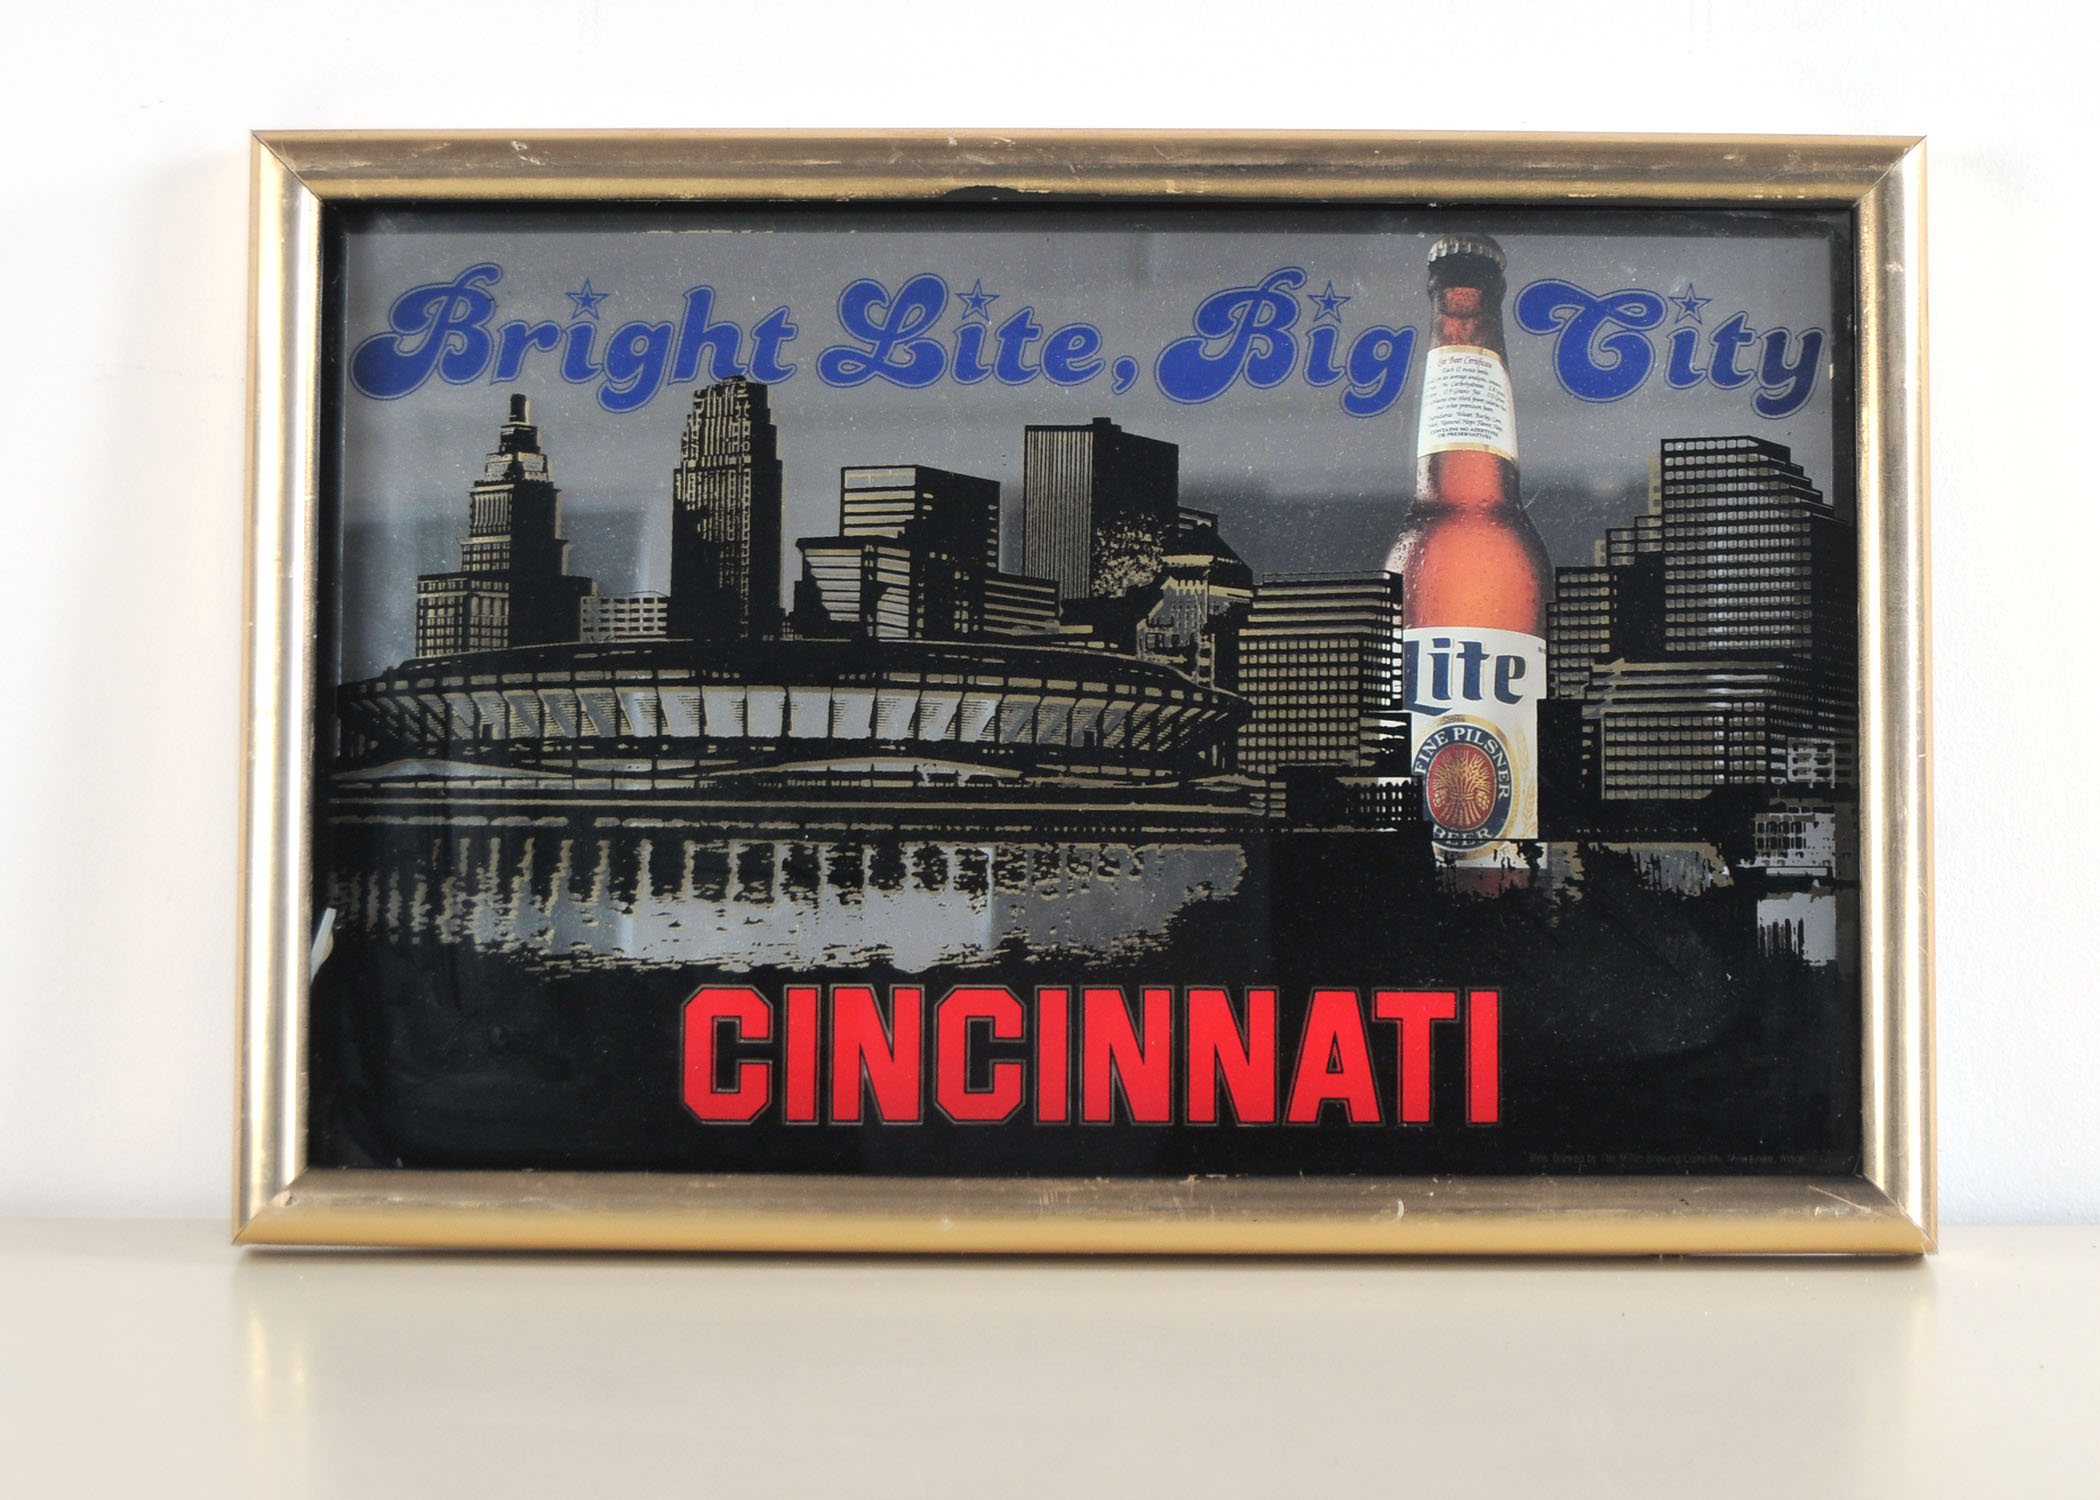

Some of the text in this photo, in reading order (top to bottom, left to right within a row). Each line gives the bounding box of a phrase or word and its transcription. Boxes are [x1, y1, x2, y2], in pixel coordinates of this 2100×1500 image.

[349, 261, 1826, 420] Bright Lite, Big City
[1403, 637, 1527, 717] Lite
[1414, 726, 1511, 800] FINE PILSNER
[680, 983, 1503, 1129] CINCINNATI
